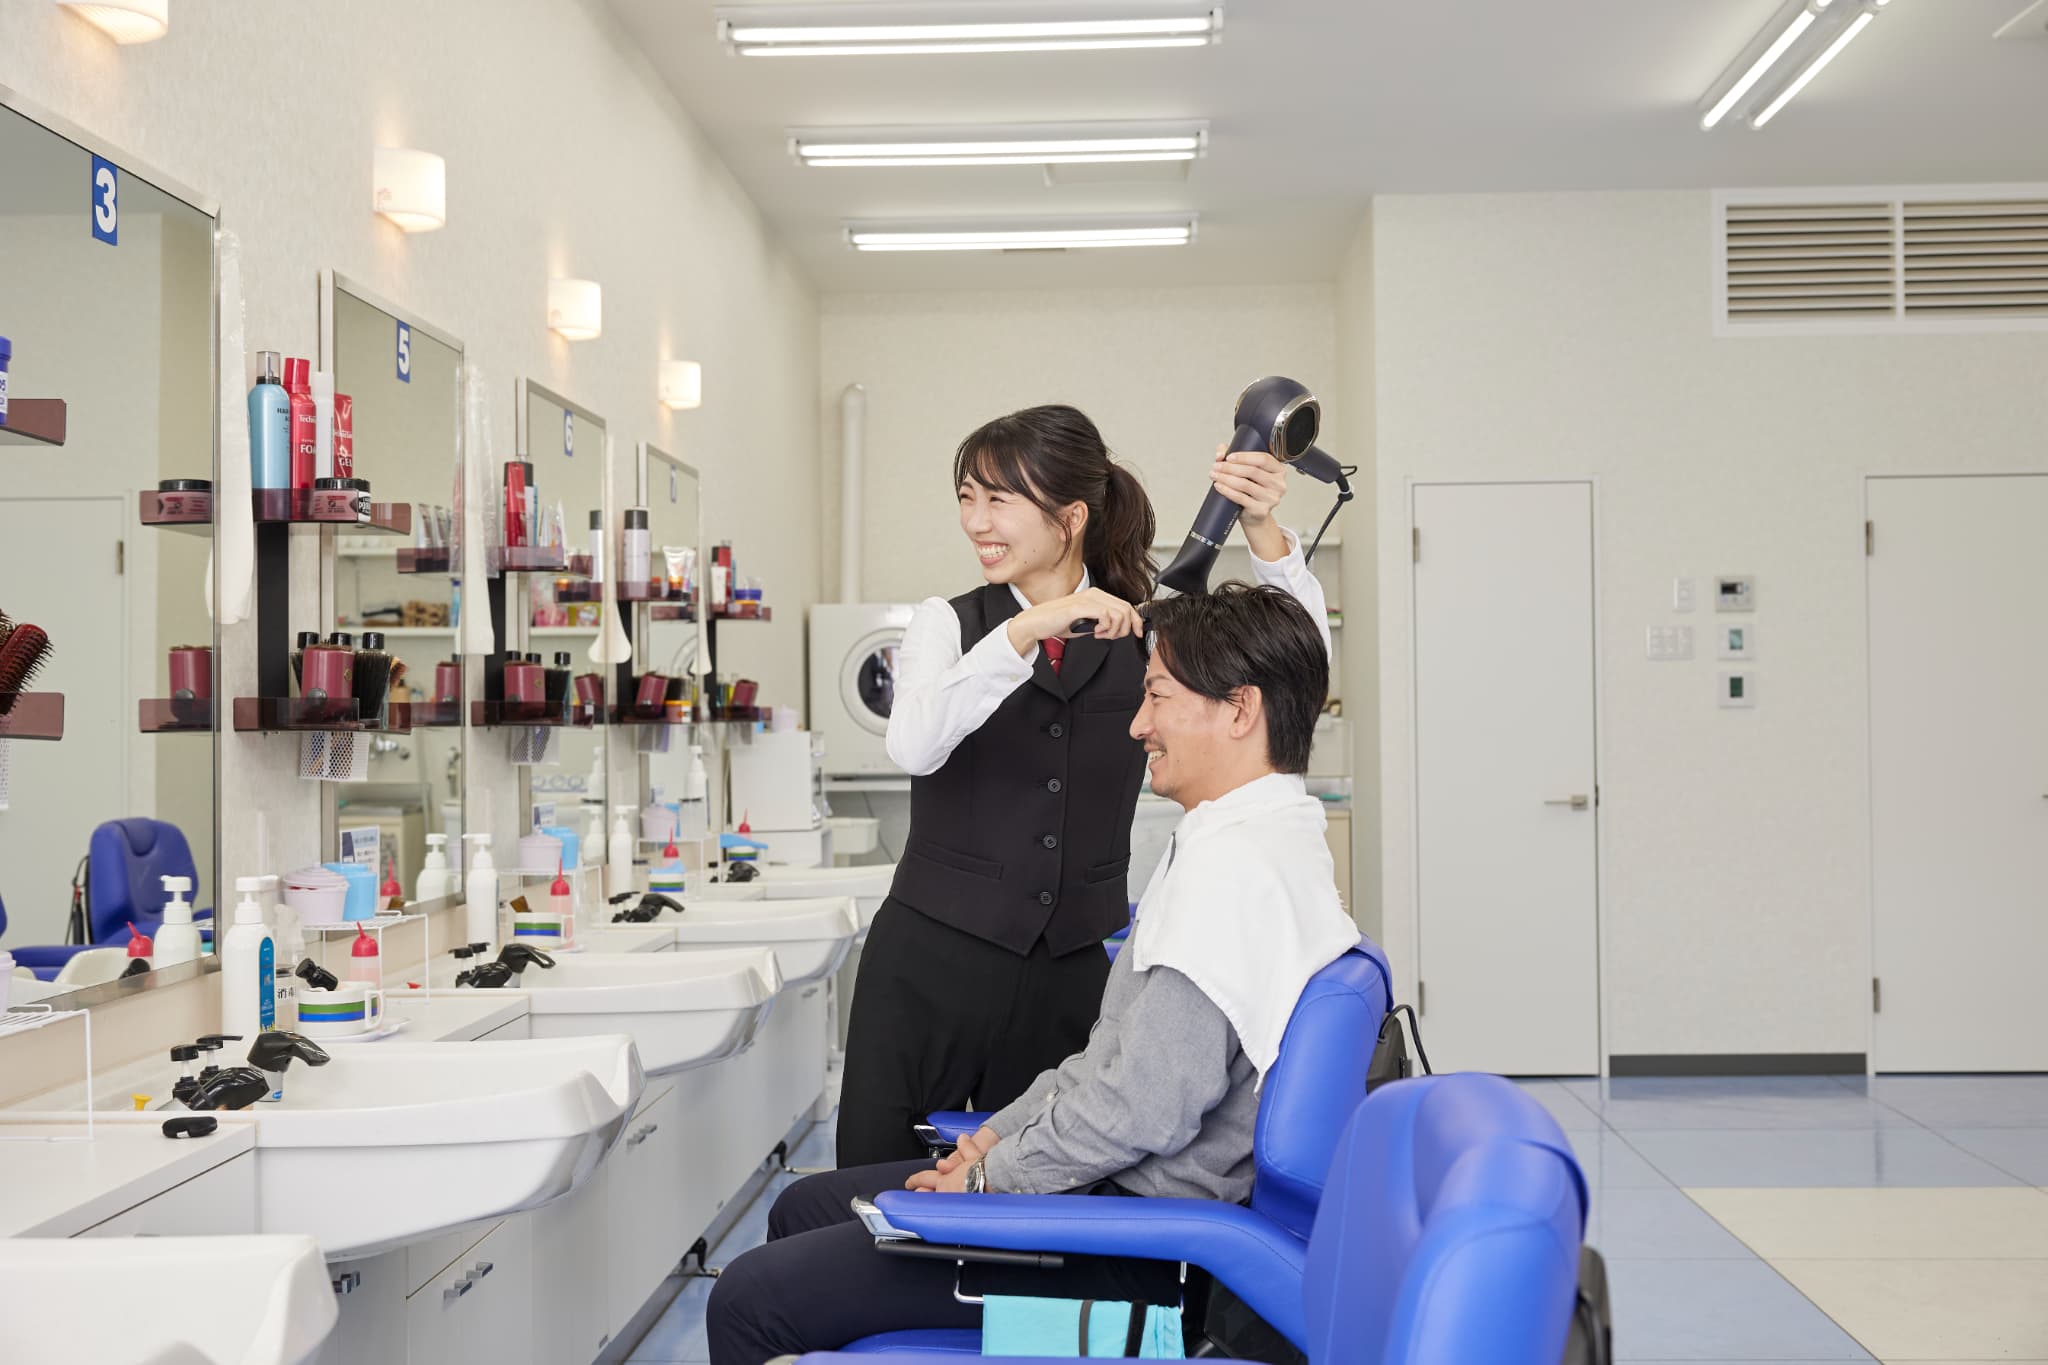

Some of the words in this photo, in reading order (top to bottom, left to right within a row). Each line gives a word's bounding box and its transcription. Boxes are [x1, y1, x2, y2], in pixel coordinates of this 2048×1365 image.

[96, 167, 116, 233] 3
[398, 328, 410, 375] 5
[565, 416, 573, 451] 6
